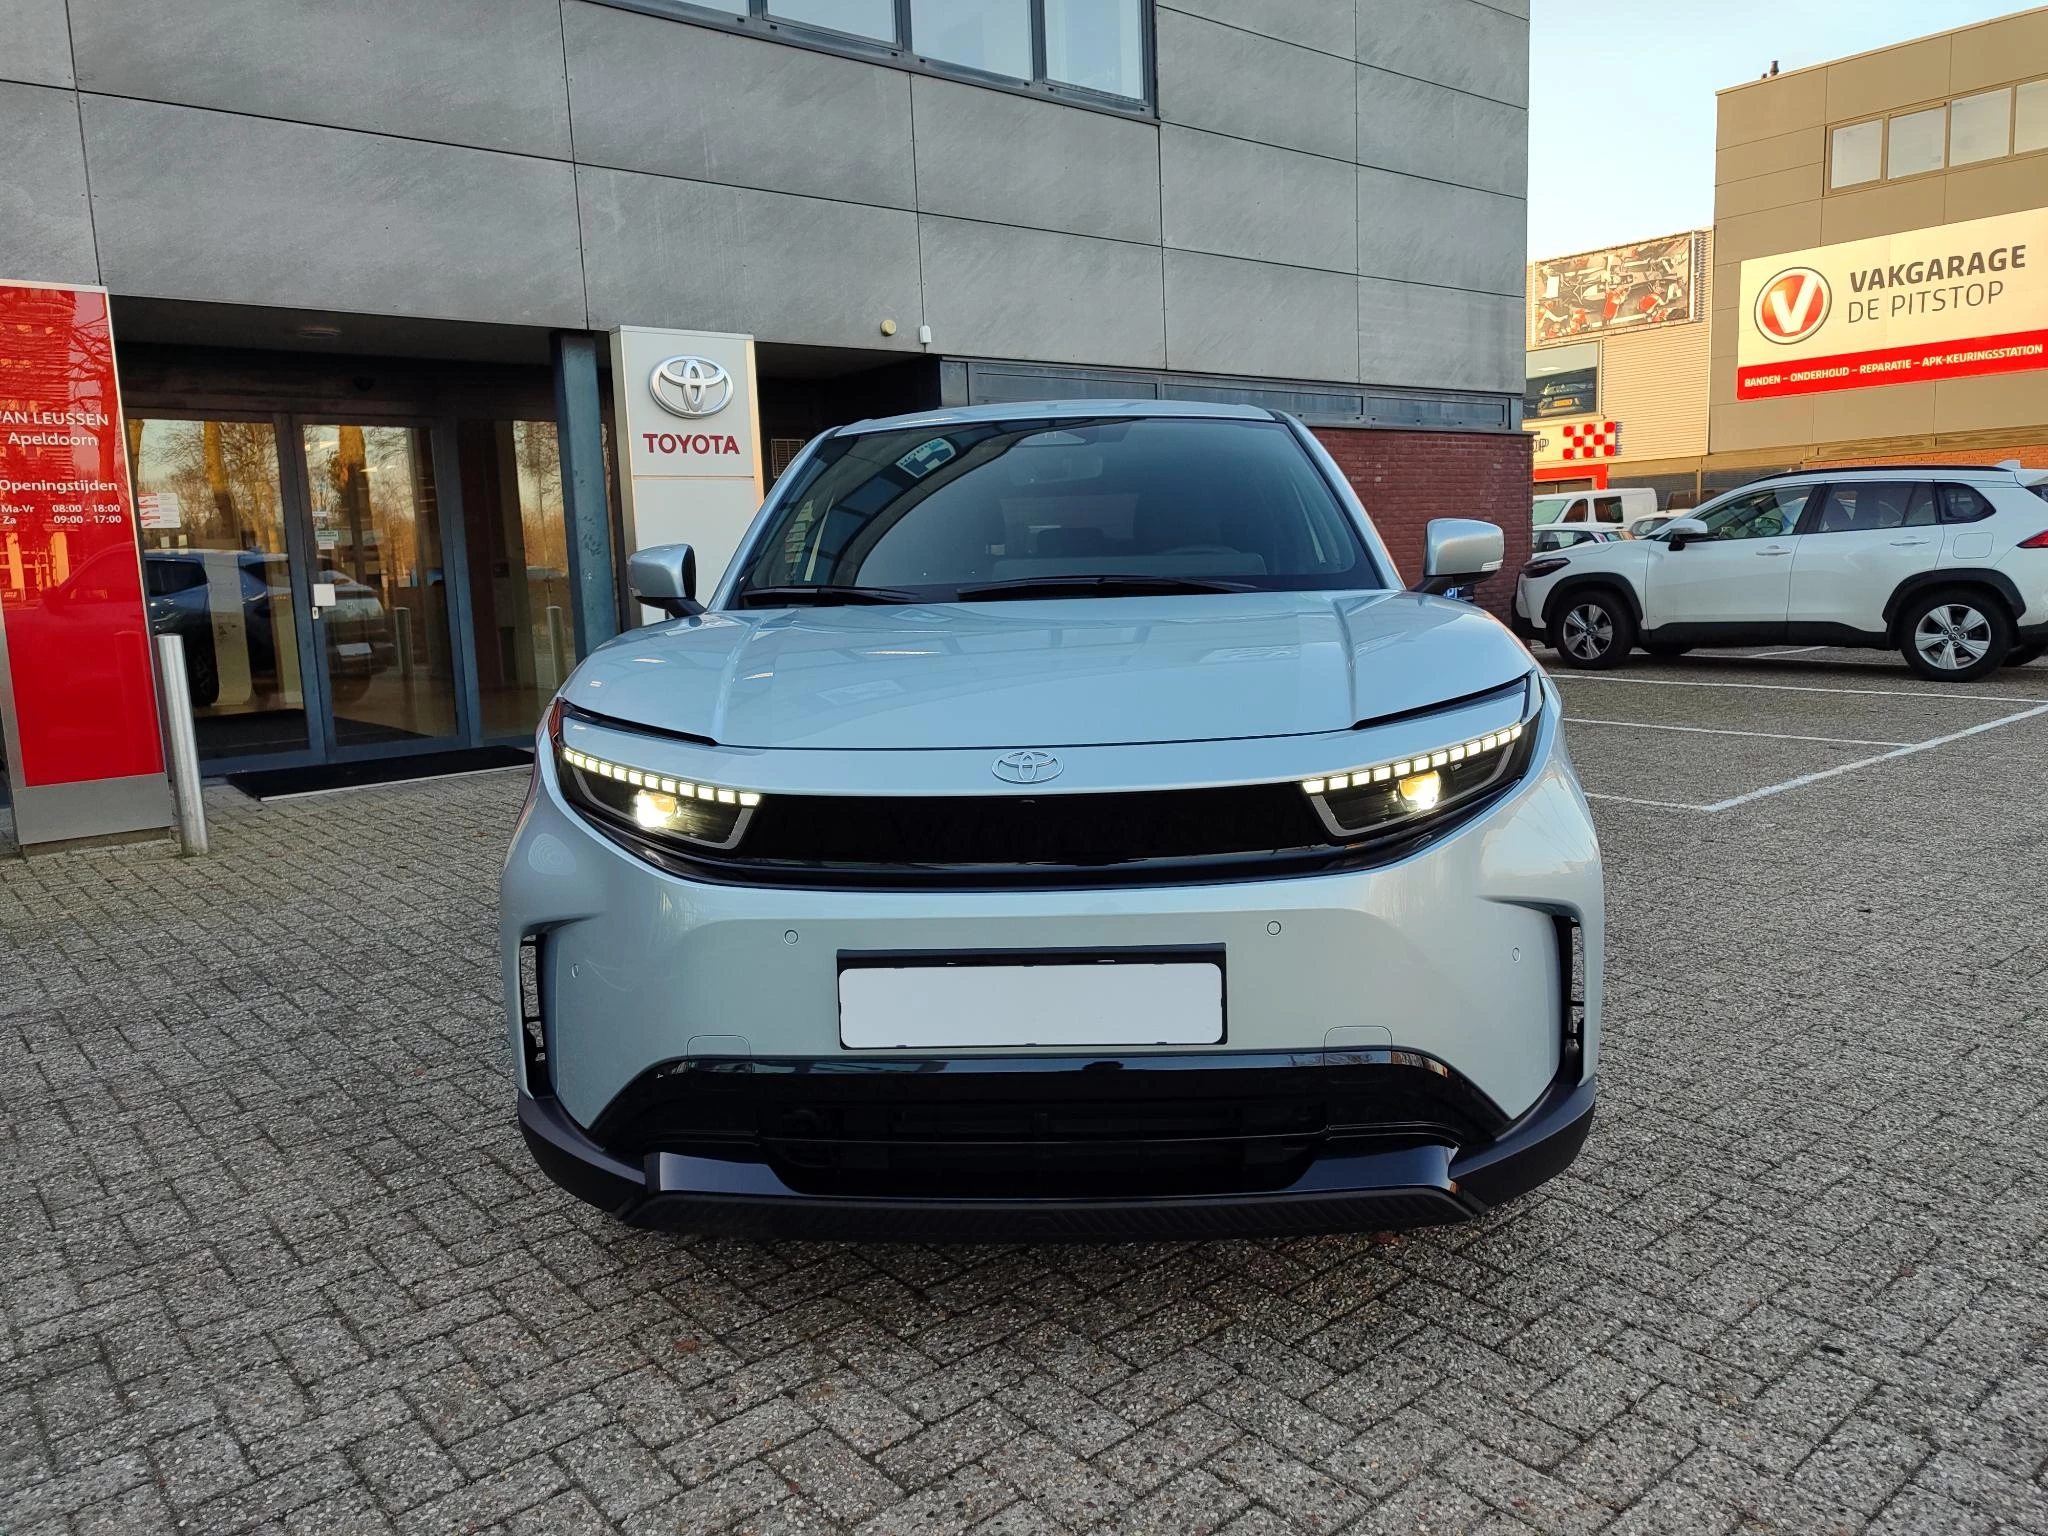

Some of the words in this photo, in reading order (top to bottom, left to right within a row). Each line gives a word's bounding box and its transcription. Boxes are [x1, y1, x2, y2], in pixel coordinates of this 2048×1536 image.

[1850, 244, 2027, 293] VAKGARAGE
[1848, 298, 1880, 324] DE
[1891, 280, 2004, 318] PITSTOP
[1744, 374, 1782, 388] BANDEN
[1790, 366, 1850, 382] ONDERHOUD
[1859, 358, 1912, 375] REPARATIE
[1922, 343, 2044, 368] APK-KEURINGSSTATION
[0, 410, 28, 424] AN
[33, 411, 110, 426] LEUSSEN
[8, 432, 98, 448] Apeldoorn
[643, 433, 740, 455] TOYOTA
[0, 479, 118, 494] Openingstijden
[1, 504, 35, 513] Ma-Vr
[52, 504, 82, 513] 08:00
[92, 504, 121, 513] 18:00
[3, 516, 17, 525] Za
[53, 515, 83, 524] 09:00
[93, 515, 122, 524] 17:00
